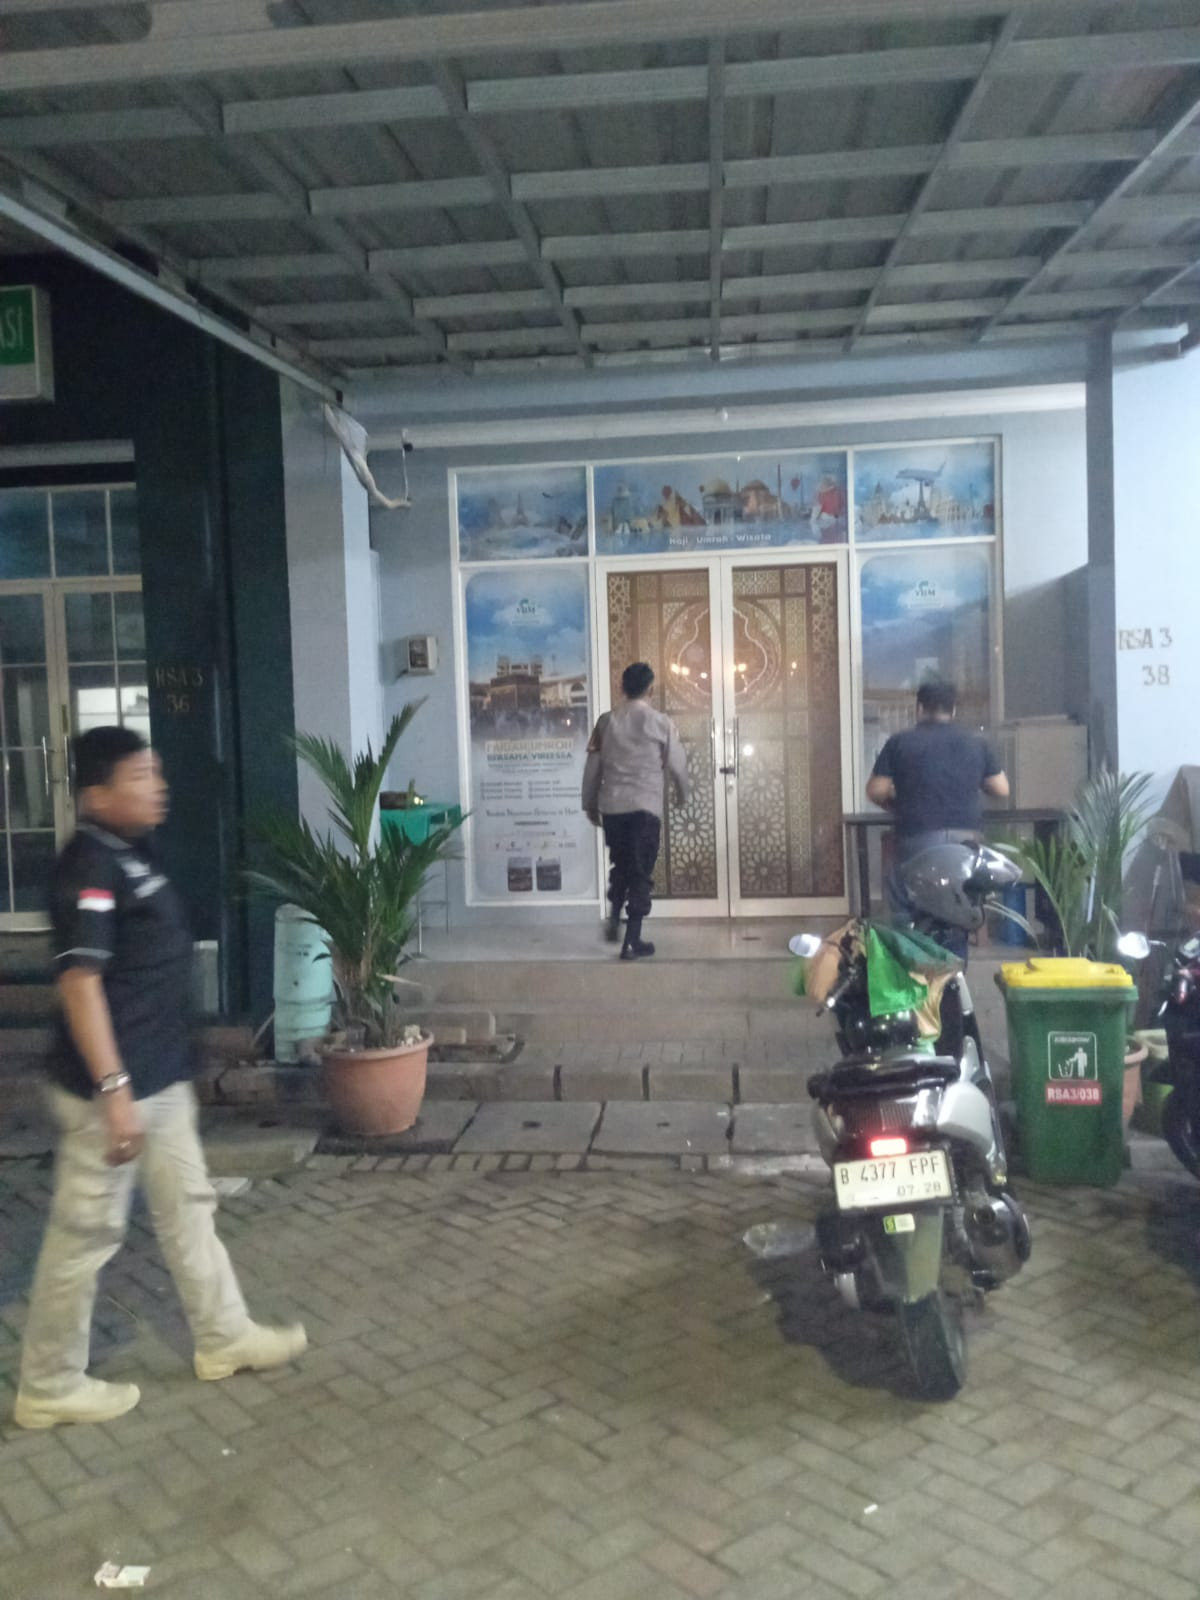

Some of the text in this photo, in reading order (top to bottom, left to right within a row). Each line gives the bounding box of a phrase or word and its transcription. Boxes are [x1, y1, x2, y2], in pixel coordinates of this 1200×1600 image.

[1118, 627, 1173, 651] RSA 3
[1142, 664, 1170, 686] 38
[167, 694, 190, 712] 36
[840, 1155, 940, 1185] B 4377 FPF
